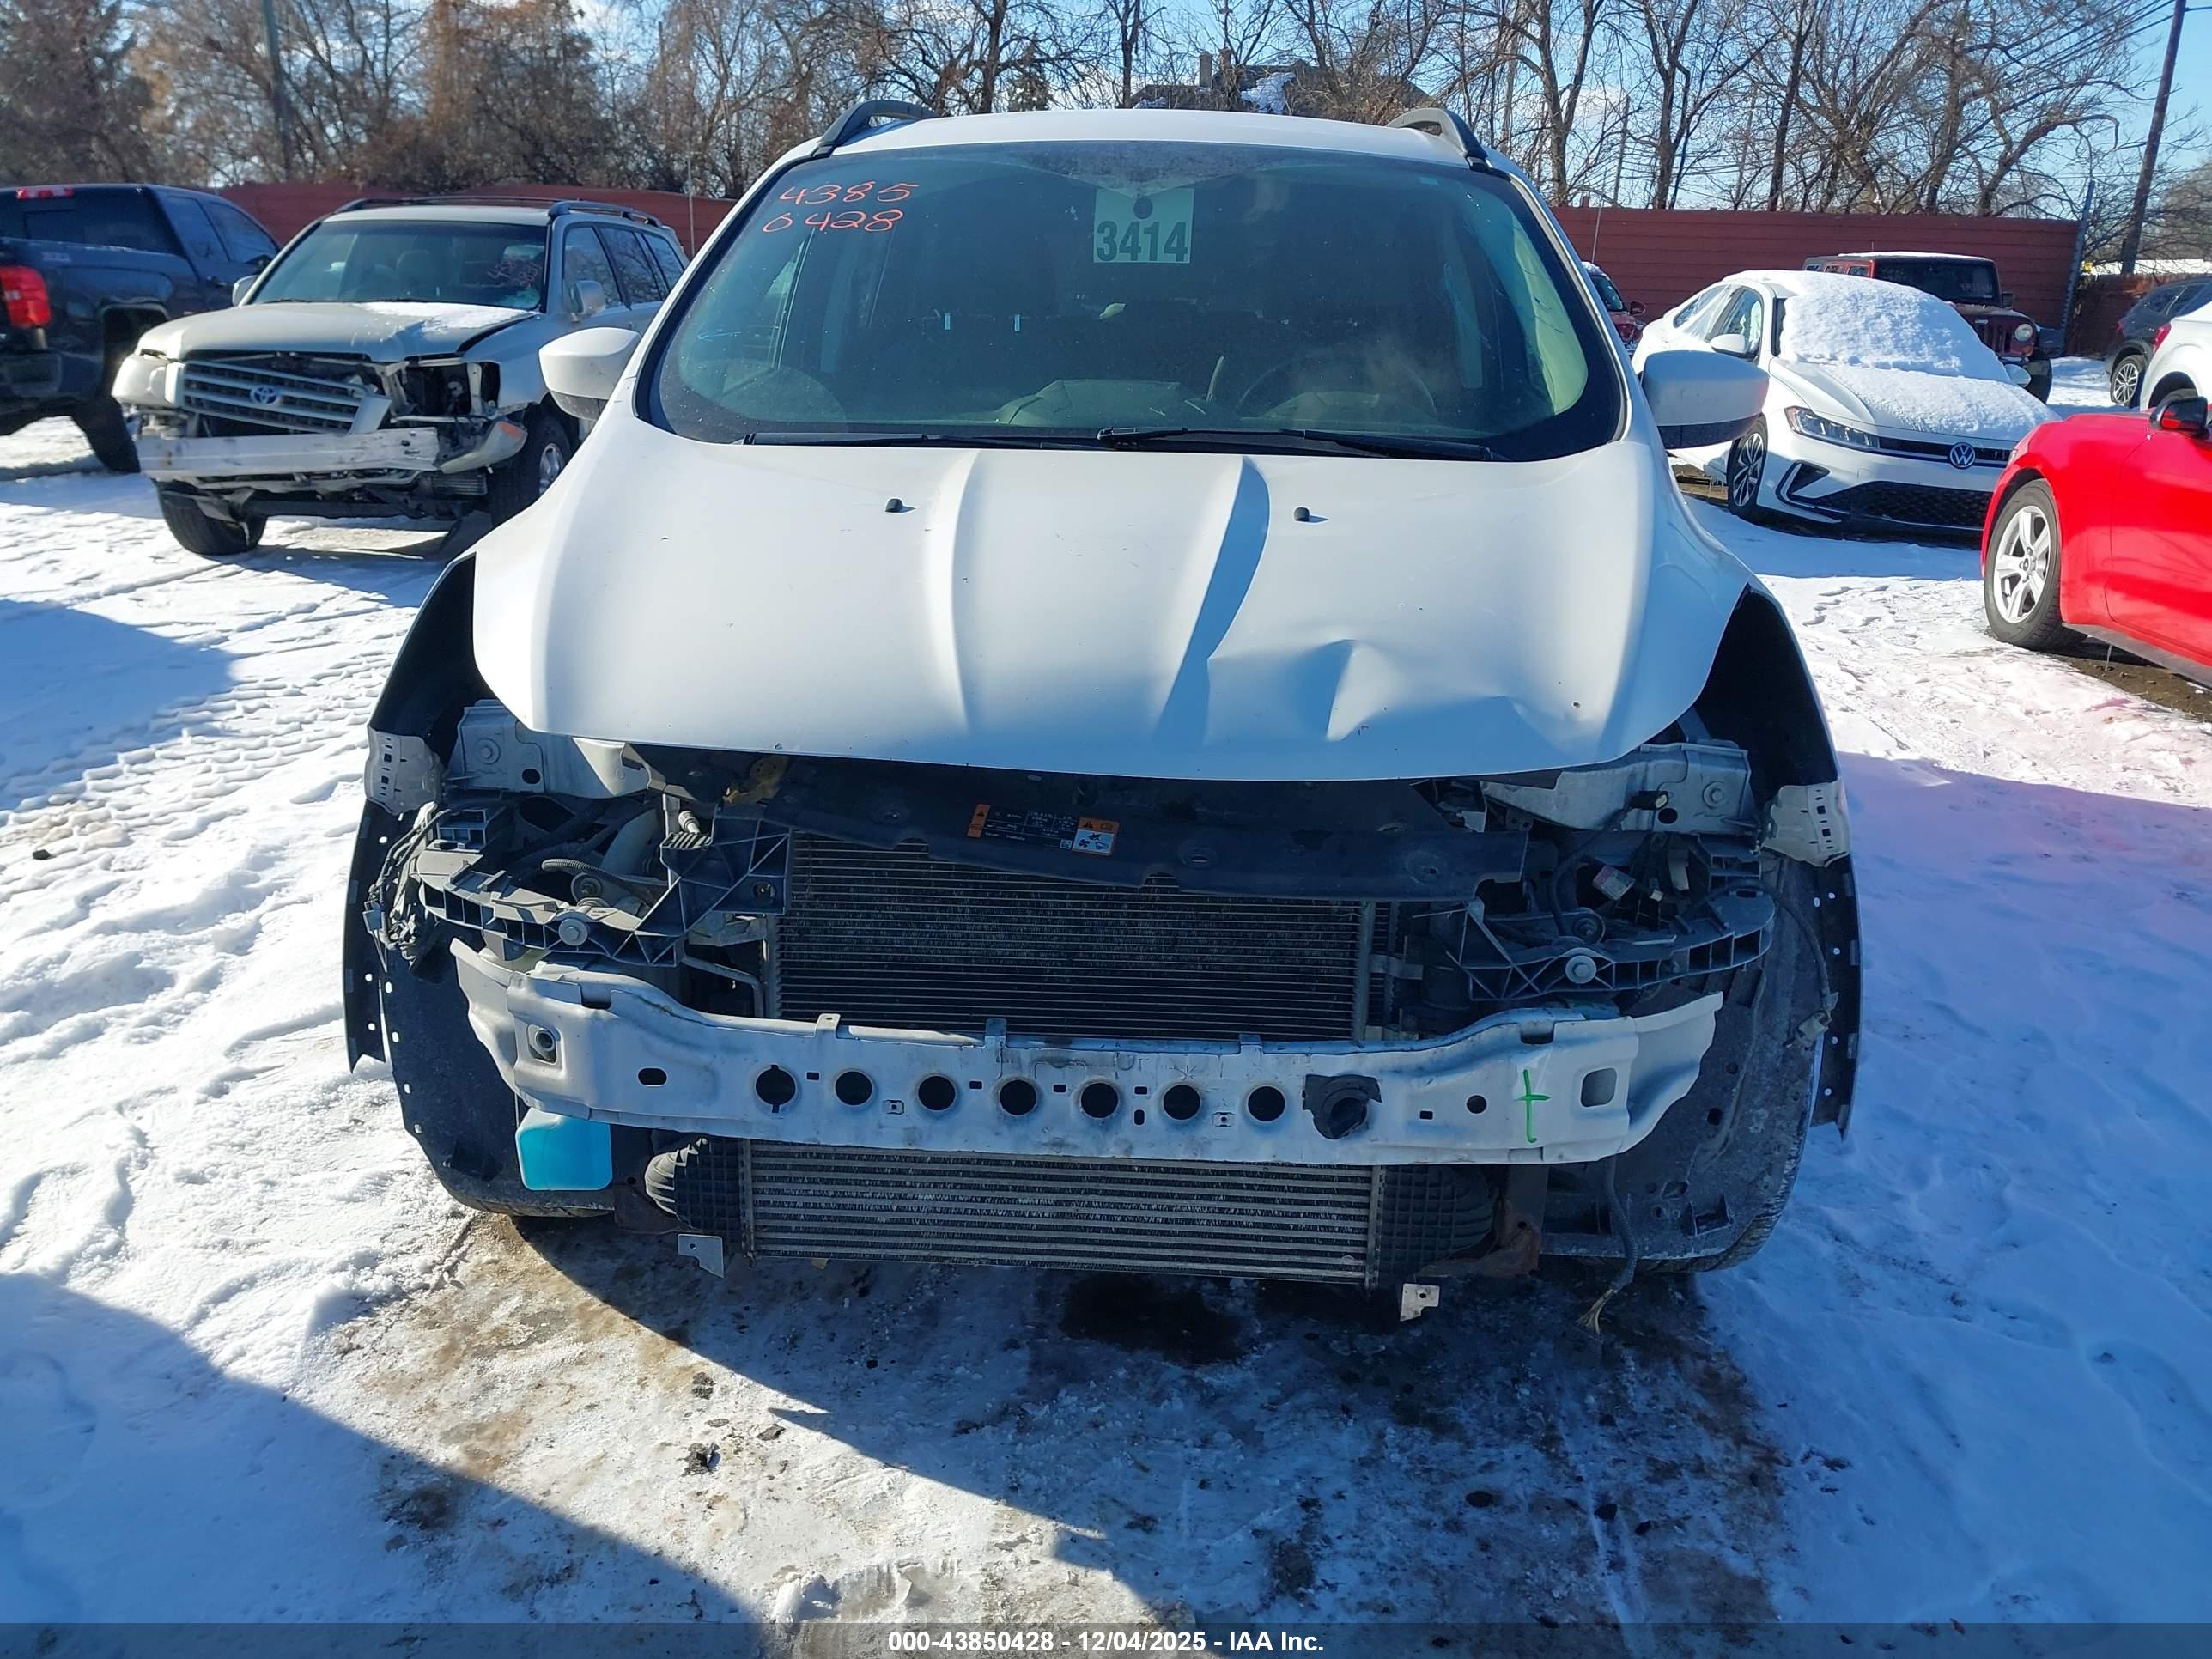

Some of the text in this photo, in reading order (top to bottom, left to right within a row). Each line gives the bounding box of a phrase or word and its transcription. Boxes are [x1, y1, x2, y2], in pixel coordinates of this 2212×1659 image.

[779, 180, 920, 206] 4385
[762, 209, 904, 234] 0428
[1097, 220, 1188, 262] 3414
